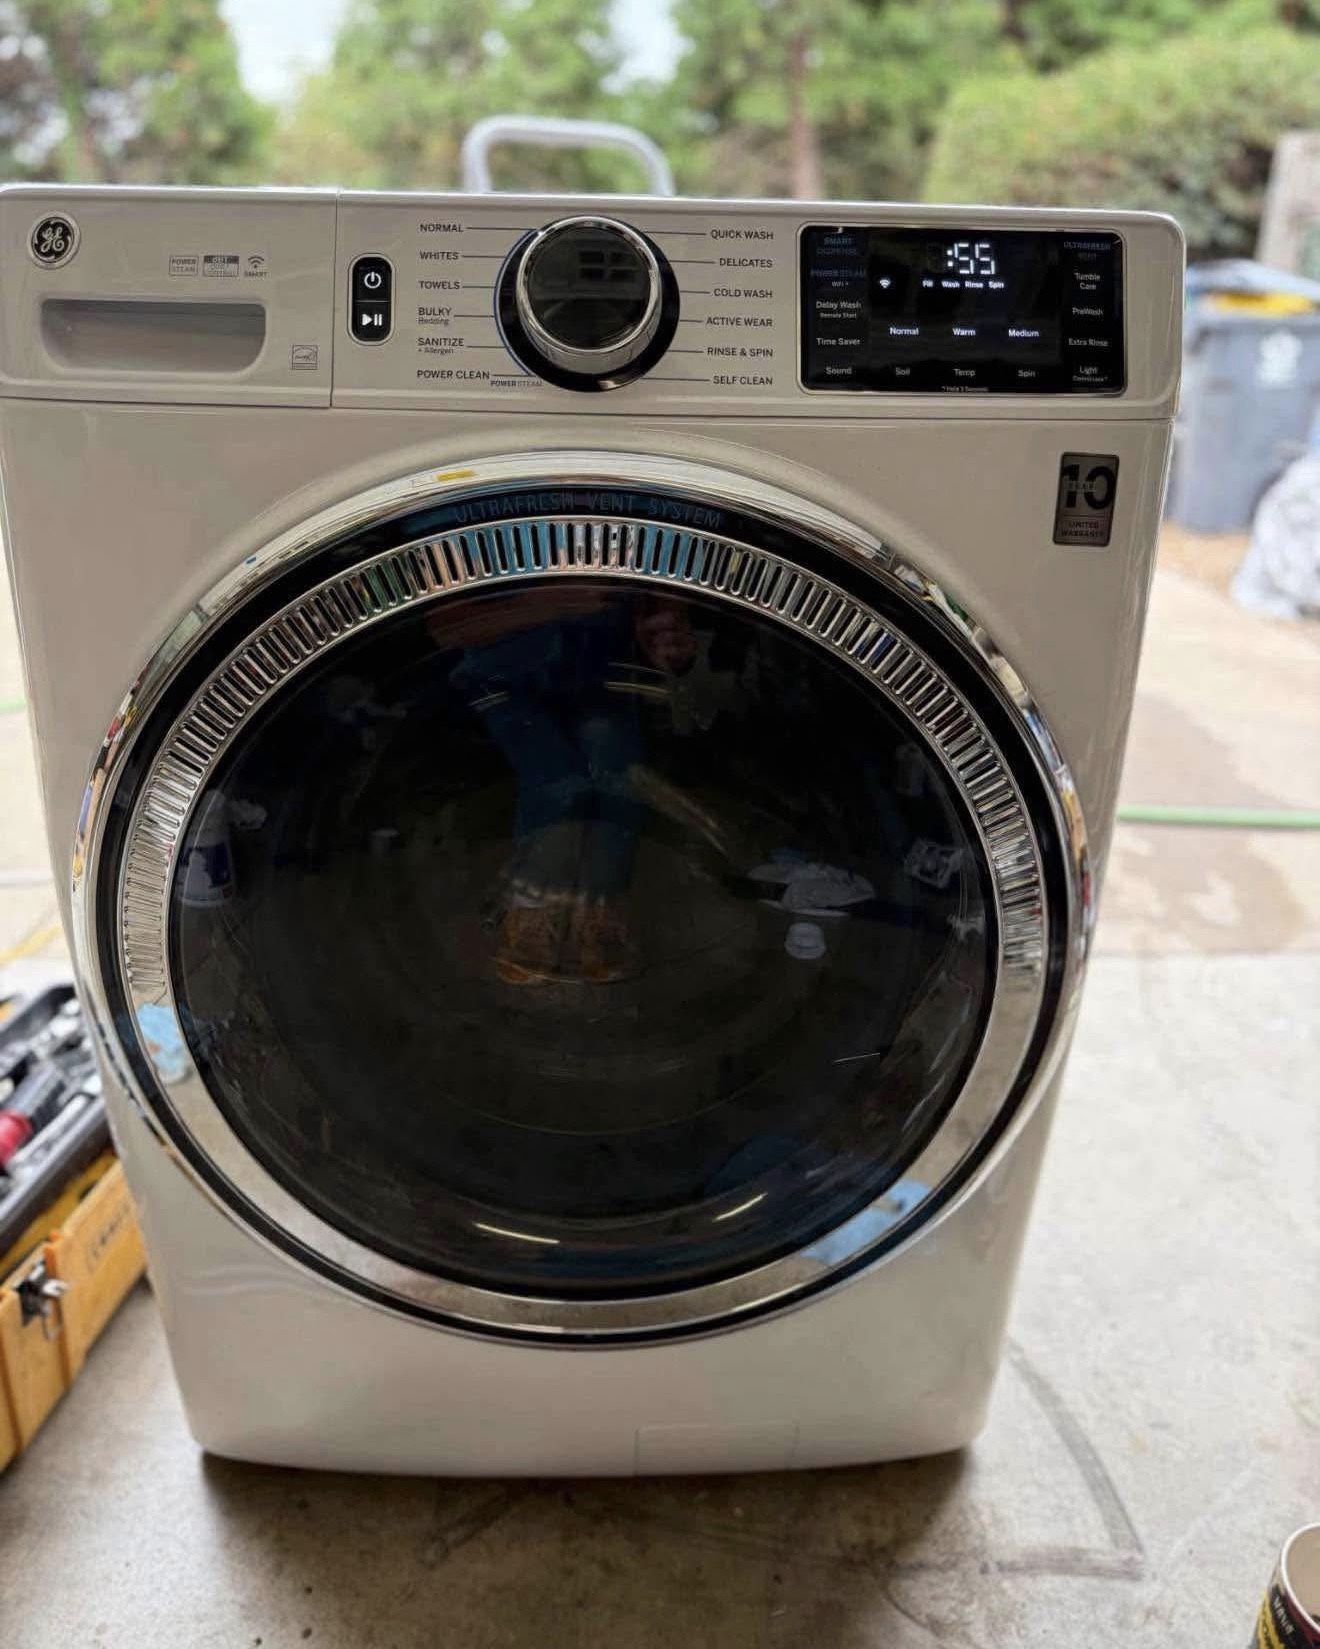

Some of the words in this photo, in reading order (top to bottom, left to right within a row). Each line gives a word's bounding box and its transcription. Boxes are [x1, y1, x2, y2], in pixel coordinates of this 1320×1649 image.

[420, 224, 464, 233] NORMAL
[710, 229, 742, 240] QUICK
[743, 230, 774, 240] WASH
[419, 251, 460, 260] WHITES
[719, 257, 773, 268] DELICATES
[418, 280, 461, 290] TOWELS
[941, 280, 961, 288] Wash
[988, 281, 1004, 289] Spin
[713, 288, 742, 298] COLD
[743, 289, 773, 298] WASH
[815, 301, 839, 310] Delay
[839, 301, 861, 309] Wash
[418, 307, 452, 316] BULKY
[706, 316, 741, 326] ACTIVE
[743, 317, 773, 327] WEAR
[889, 327, 919, 336] Normal
[952, 328, 976, 337] Warm
[1008, 329, 1040, 338] Medium
[417, 337, 465, 347] SANITIZE
[815, 337, 837, 346] Time
[838, 337, 861, 346] Saver
[707, 347, 737, 357] RINSE
[739, 347, 747, 357] &
[749, 348, 774, 358] SPIN
[416, 370, 454, 380] POWER
[455, 370, 490, 380] CLEAN
[825, 367, 853, 375] Sound
[895, 367, 911, 376] Soil
[953, 368, 976, 378] Temp
[1018, 369, 1036, 378] Spin
[1079, 365, 1099, 375] Light
[712, 375, 738, 386] SELF
[739, 376, 774, 386] CLEAN
[1060, 464, 1116, 510] 10
[455, 490, 575, 522] ULTRAFRESH
[584, 492, 634, 513] VENT
[647, 496, 721, 529] SYSTEM
